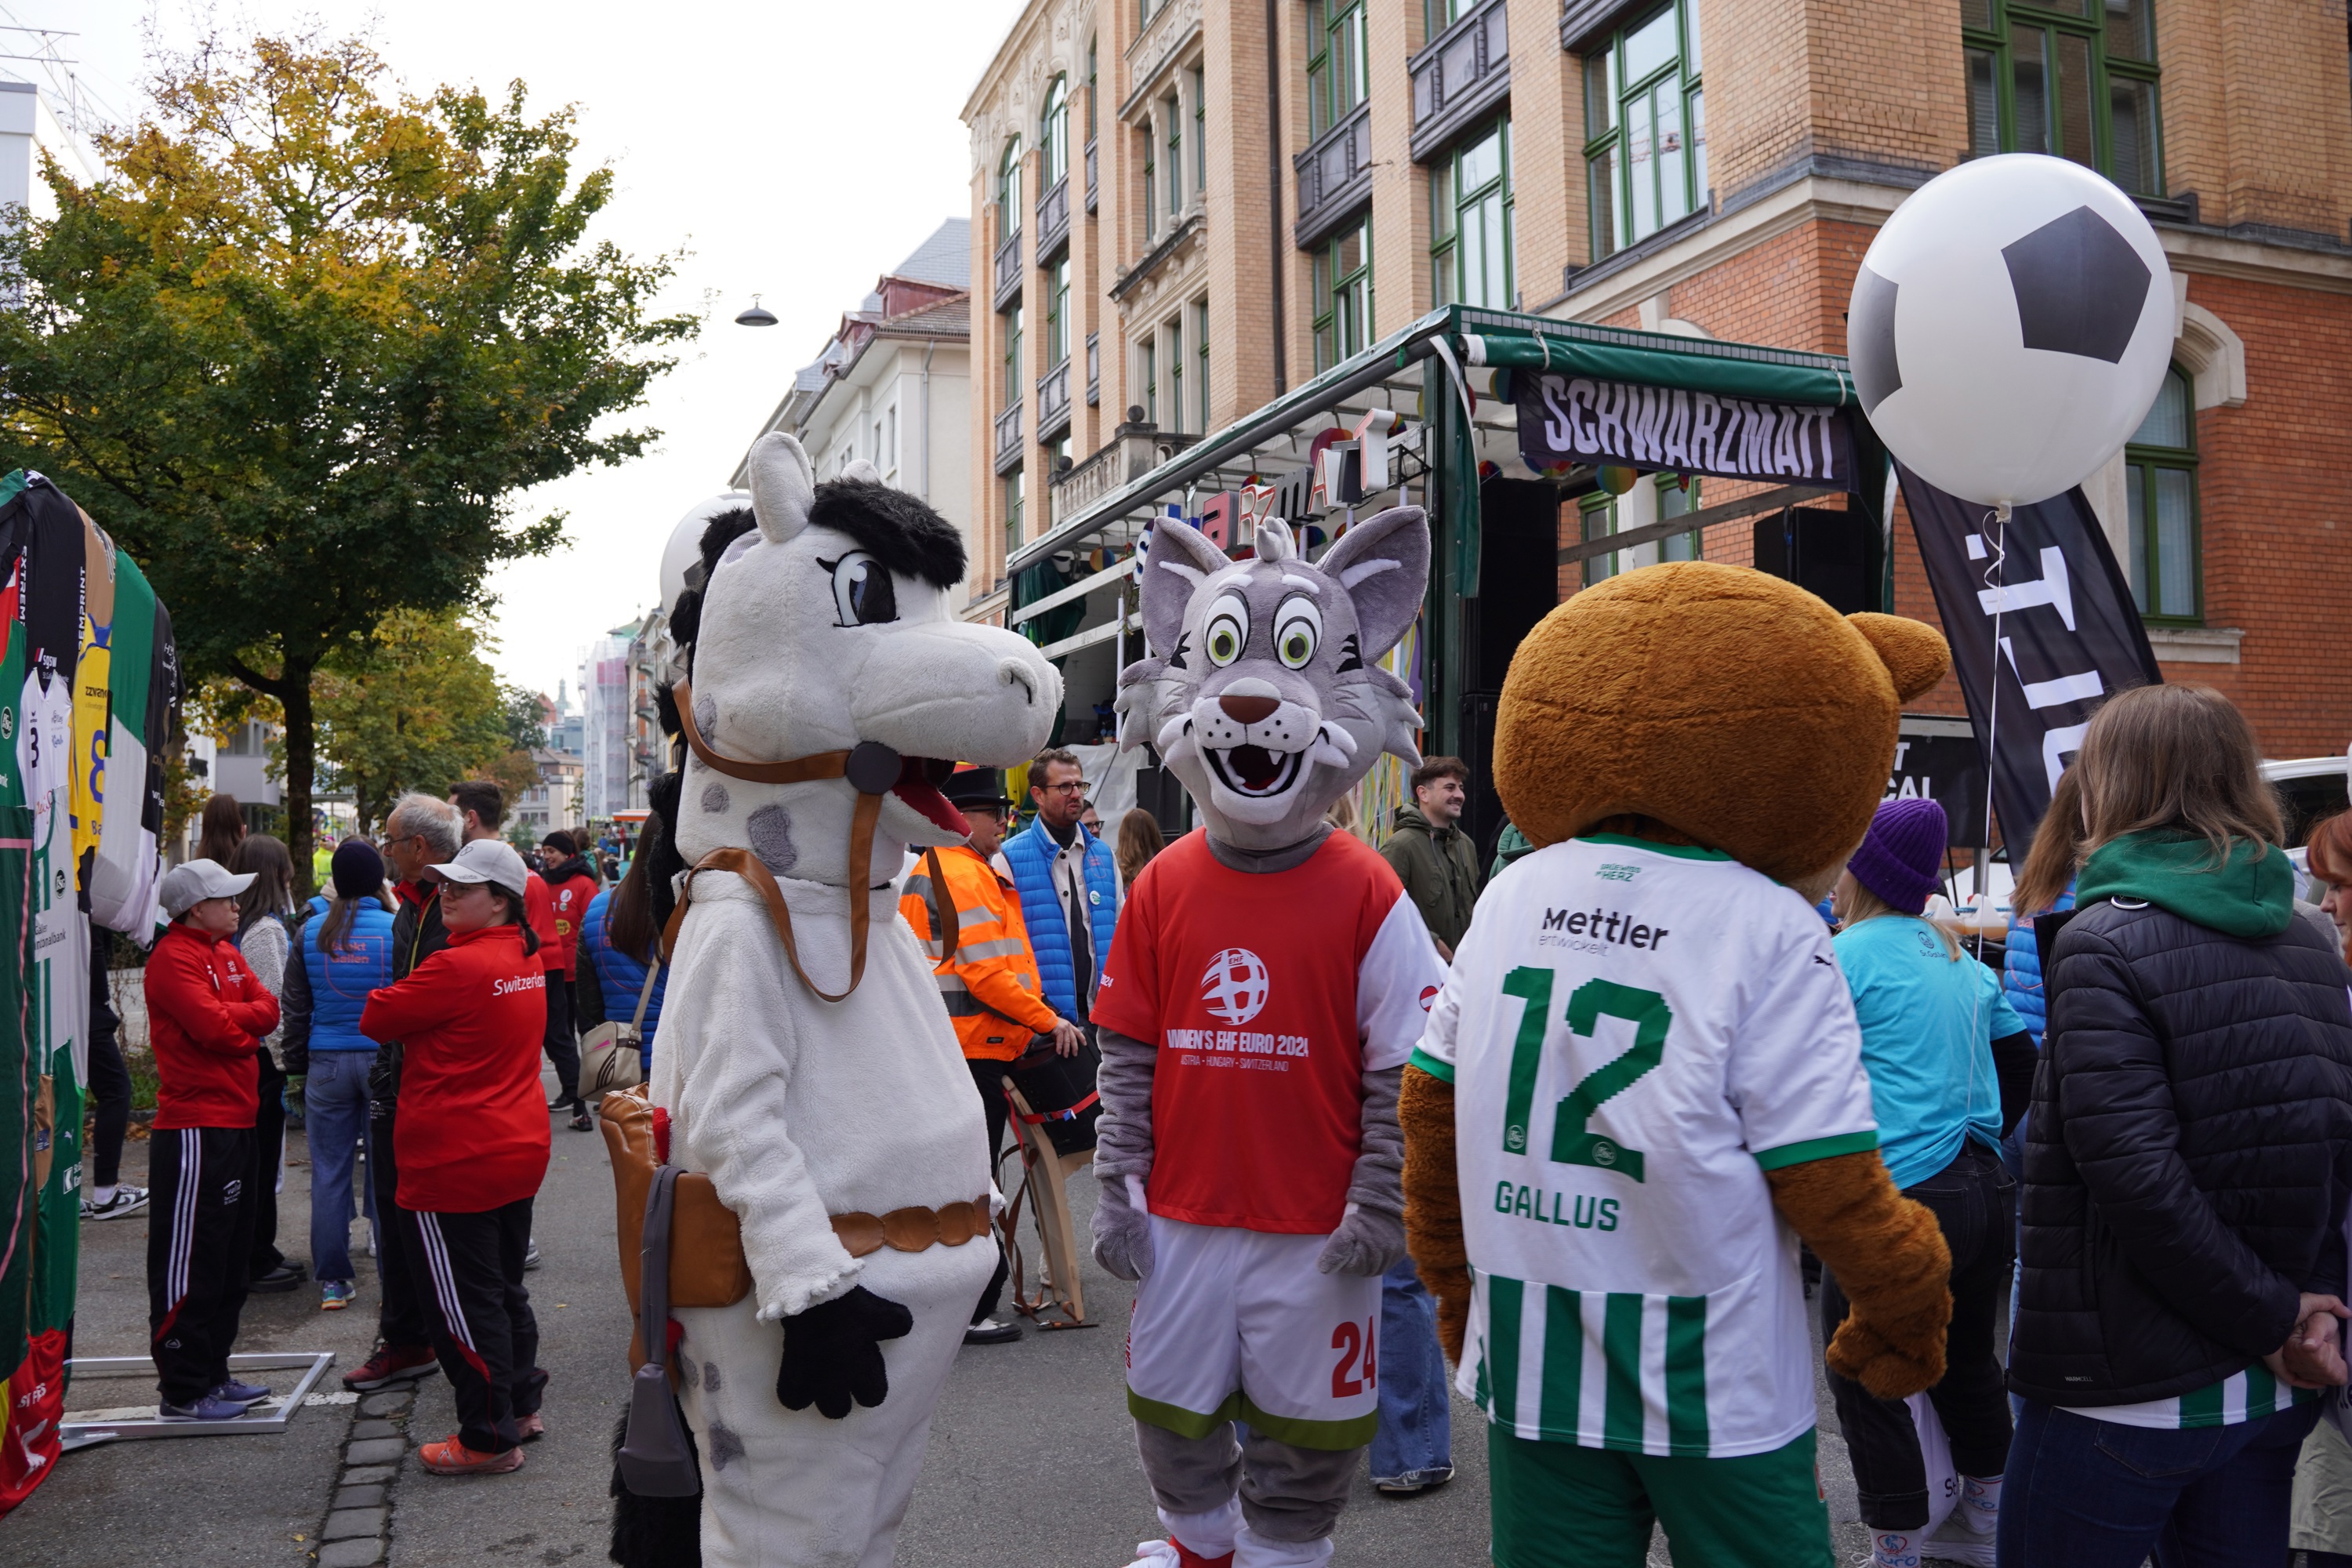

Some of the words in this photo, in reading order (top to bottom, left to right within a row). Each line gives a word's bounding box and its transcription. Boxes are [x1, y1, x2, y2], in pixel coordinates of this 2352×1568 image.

[1540, 375, 1835, 480] SCHWARZMATT
[43, 655, 57, 669] sgsw
[1538, 935, 1609, 956] entwickelt
[1542, 907, 1670, 951] Mettler
[1229, 955, 1243, 964] EHF
[1216, 1031, 1238, 1051] EHF
[1239, 1033, 1275, 1054] EURO
[1276, 1035, 1309, 1058] 2024
[1501, 965, 1674, 1184] 12
[1495, 1181, 1621, 1232] GALLUS
[1331, 1316, 1376, 1399] 24
